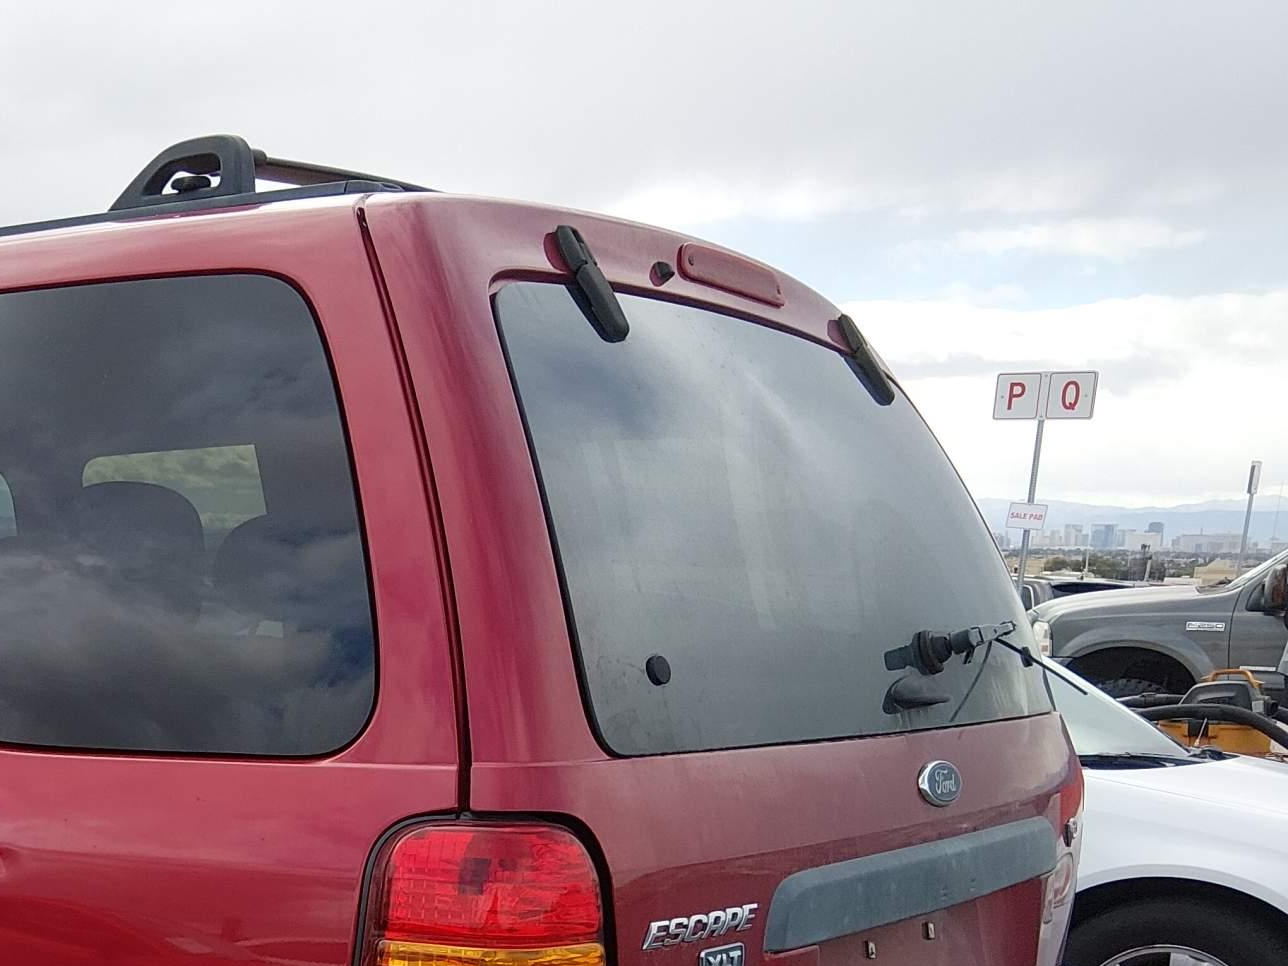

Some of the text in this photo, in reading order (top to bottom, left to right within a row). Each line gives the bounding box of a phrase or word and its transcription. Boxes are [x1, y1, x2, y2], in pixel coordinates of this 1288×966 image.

[1007, 382, 1026, 410] P
[1061, 380, 1080, 411] Q
[1010, 512, 1043, 521] SALE PAD
[935, 769, 956, 794] Ford
[642, 903, 758, 950] ESCAPE
